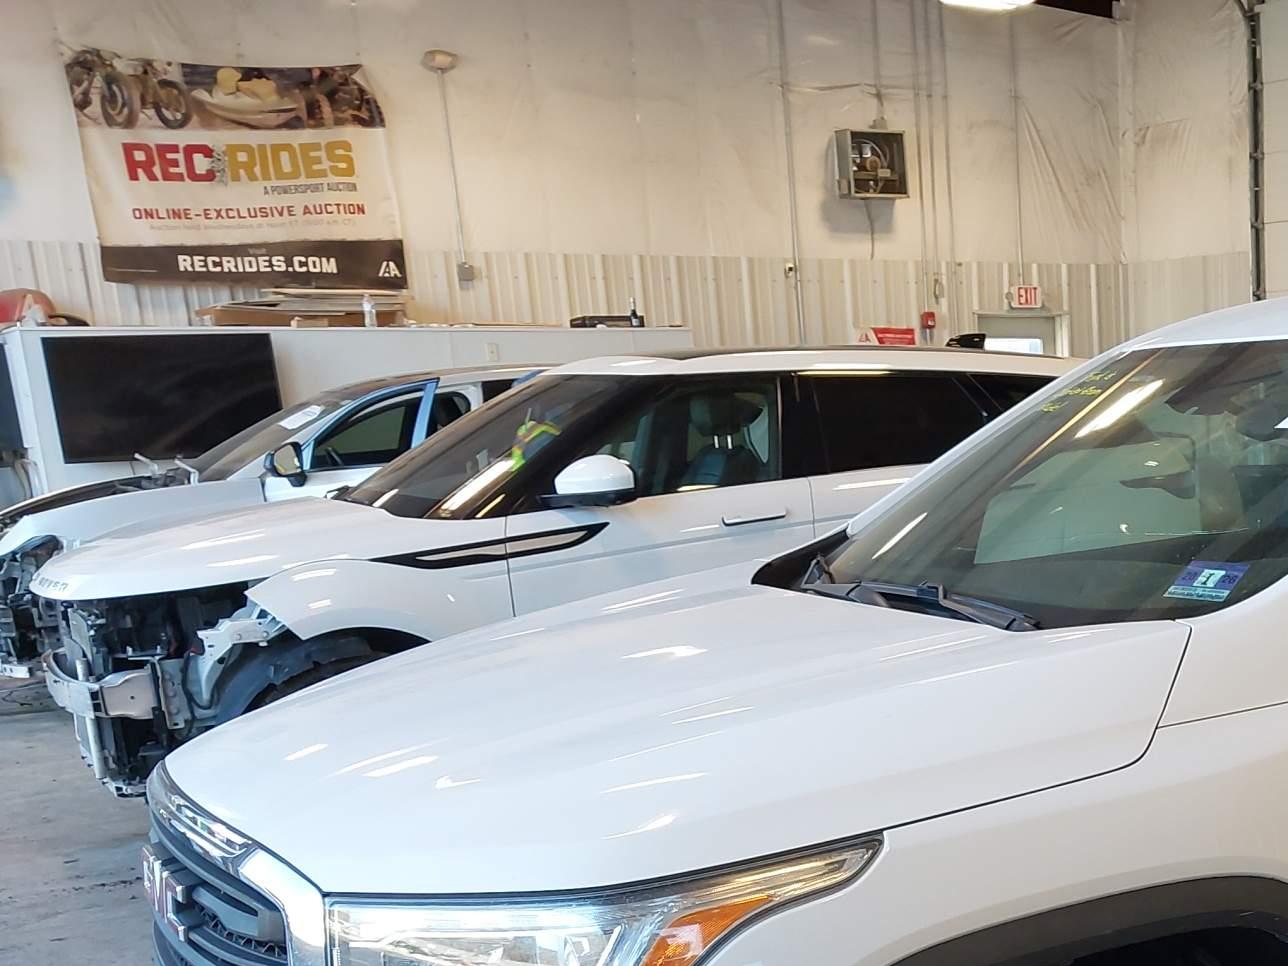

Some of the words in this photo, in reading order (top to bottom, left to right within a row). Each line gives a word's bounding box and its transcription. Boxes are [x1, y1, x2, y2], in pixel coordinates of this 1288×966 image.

[132, 204, 297, 221] ONLINE-EXCLUSIVE
[302, 203, 366, 216] AUCTION
[177, 254, 338, 274] RECRIDES.COM
[1017, 286, 1038, 305] EXIT
